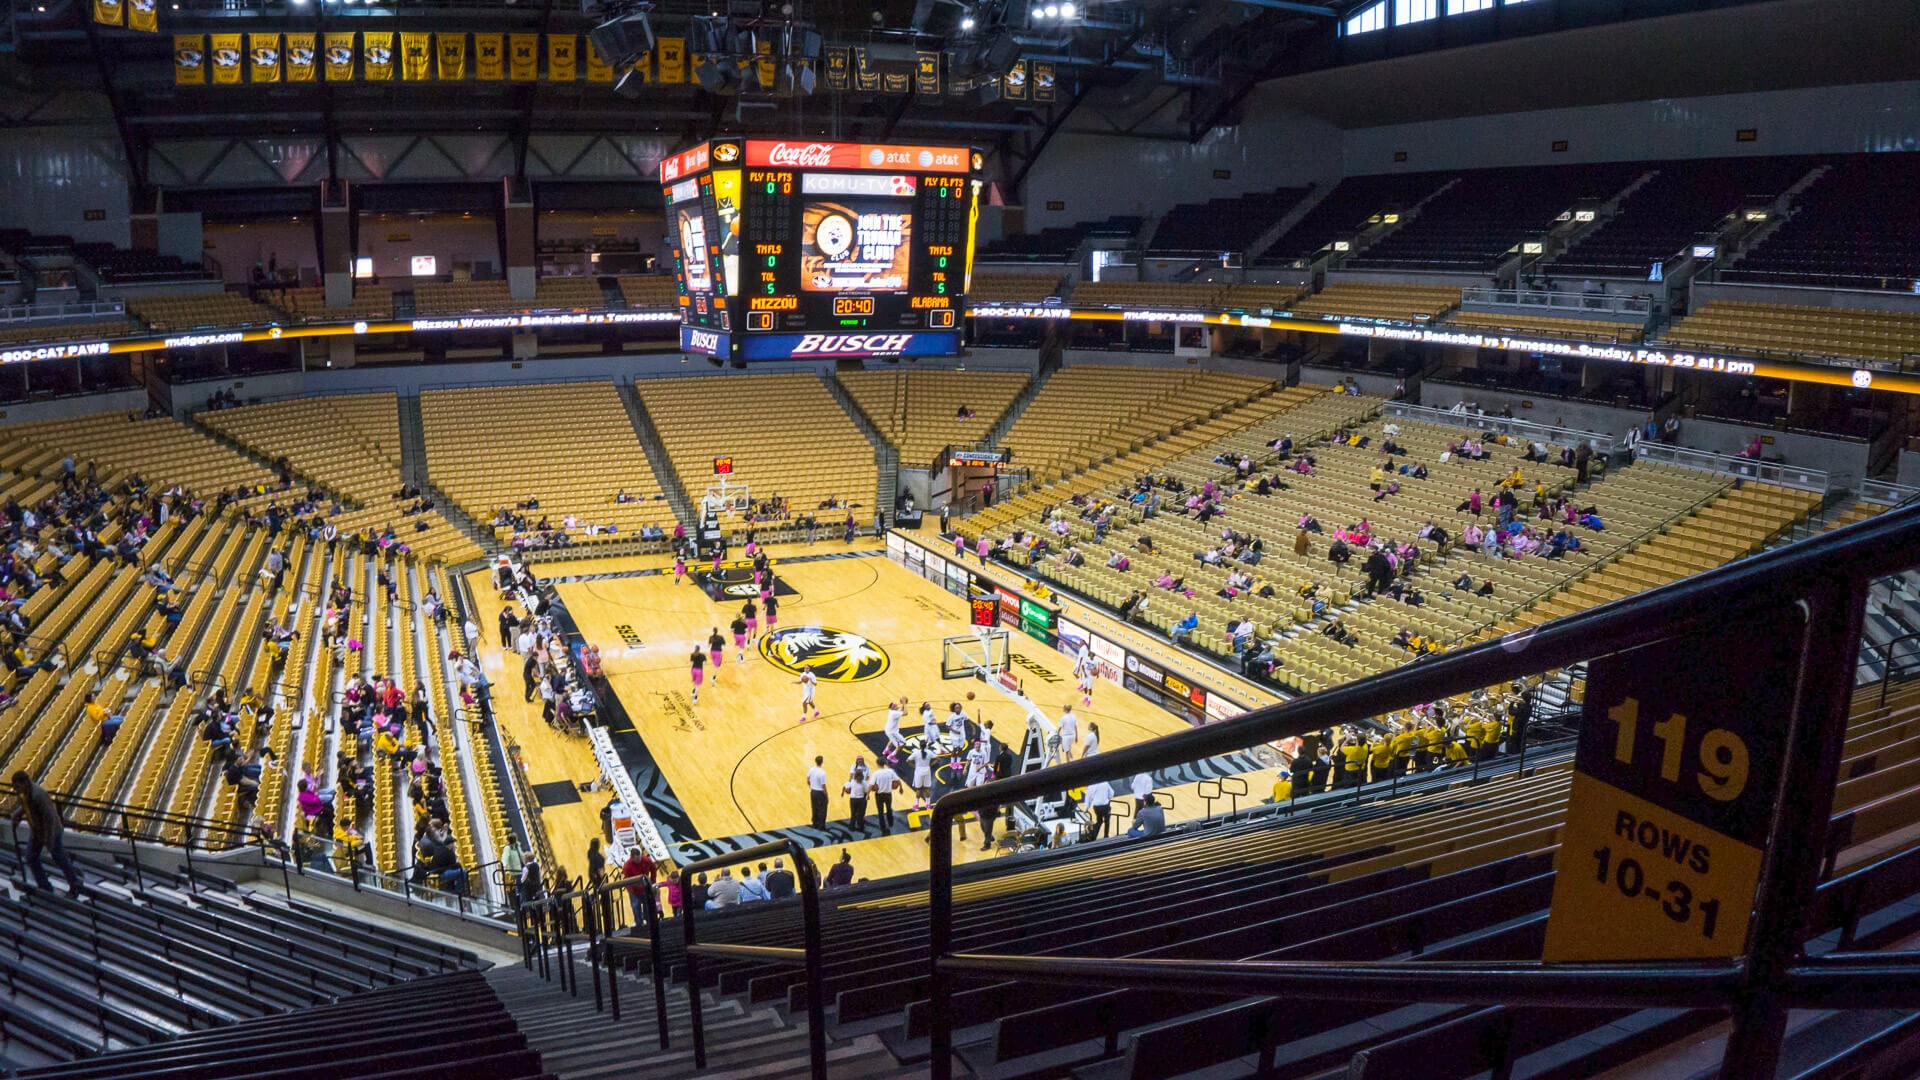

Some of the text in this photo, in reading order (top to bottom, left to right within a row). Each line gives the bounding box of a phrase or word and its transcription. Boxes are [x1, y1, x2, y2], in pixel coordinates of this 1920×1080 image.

[886, 152, 911, 164] at&t
[935, 153, 960, 166] at&t
[749, 172, 793, 182] PLY FL PTS
[805, 177, 888, 191] KOMU-TV
[924, 177, 964, 188] PLY FL PTS
[767, 182, 792, 194] 0 0
[940, 187, 962, 199] 0 0
[857, 215, 903, 231] JOIN THE
[767, 255, 776, 268] 0
[939, 256, 947, 268] 0
[761, 272, 776, 282] TOL
[932, 272, 946, 282] TOL
[767, 283, 775, 294] 5
[937, 282, 945, 294] 5
[751, 297, 798, 310] MIZZOU
[836, 299, 872, 314] 20:40
[911, 297, 950, 308] ALABAMA
[943, 312, 952, 326] 0
[972, 307, 1071, 319] 1-800-CAT PAWS
[1123, 310, 1204, 322] mutigers.com
[412, 319, 459, 331] Mizzou
[460, 317, 519, 328] Women's
[521, 314, 588, 326] Basketball
[589, 314, 604, 324] vs
[761, 313, 771, 328] 0
[165, 332, 243, 348] mutigers.com
[692, 330, 719, 350] BUSCH
[792, 334, 913, 353] BUSCH
[67, 342, 110, 357] PAWS
[1339, 323, 1374, 336] Mizzou
[1374, 326, 1422, 341] Women's
[1423, 330, 1483, 346] Basketball
[1484, 336, 1499, 348] vs
[1672, 354, 1695, 367] 23
[1698, 357, 1715, 370] at
[1717, 358, 1725, 371] 1
[1727, 361, 1755, 374] pm
[1001, 592, 1020, 610] TOYOTA
[1009, 653, 1065, 683] TIGERS
[1139, 663, 1164, 683] MIDWEST
[1607, 696, 1750, 802] 119
[1615, 810, 1711, 875] ROWS
[1593, 846, 1721, 940] 10-31
